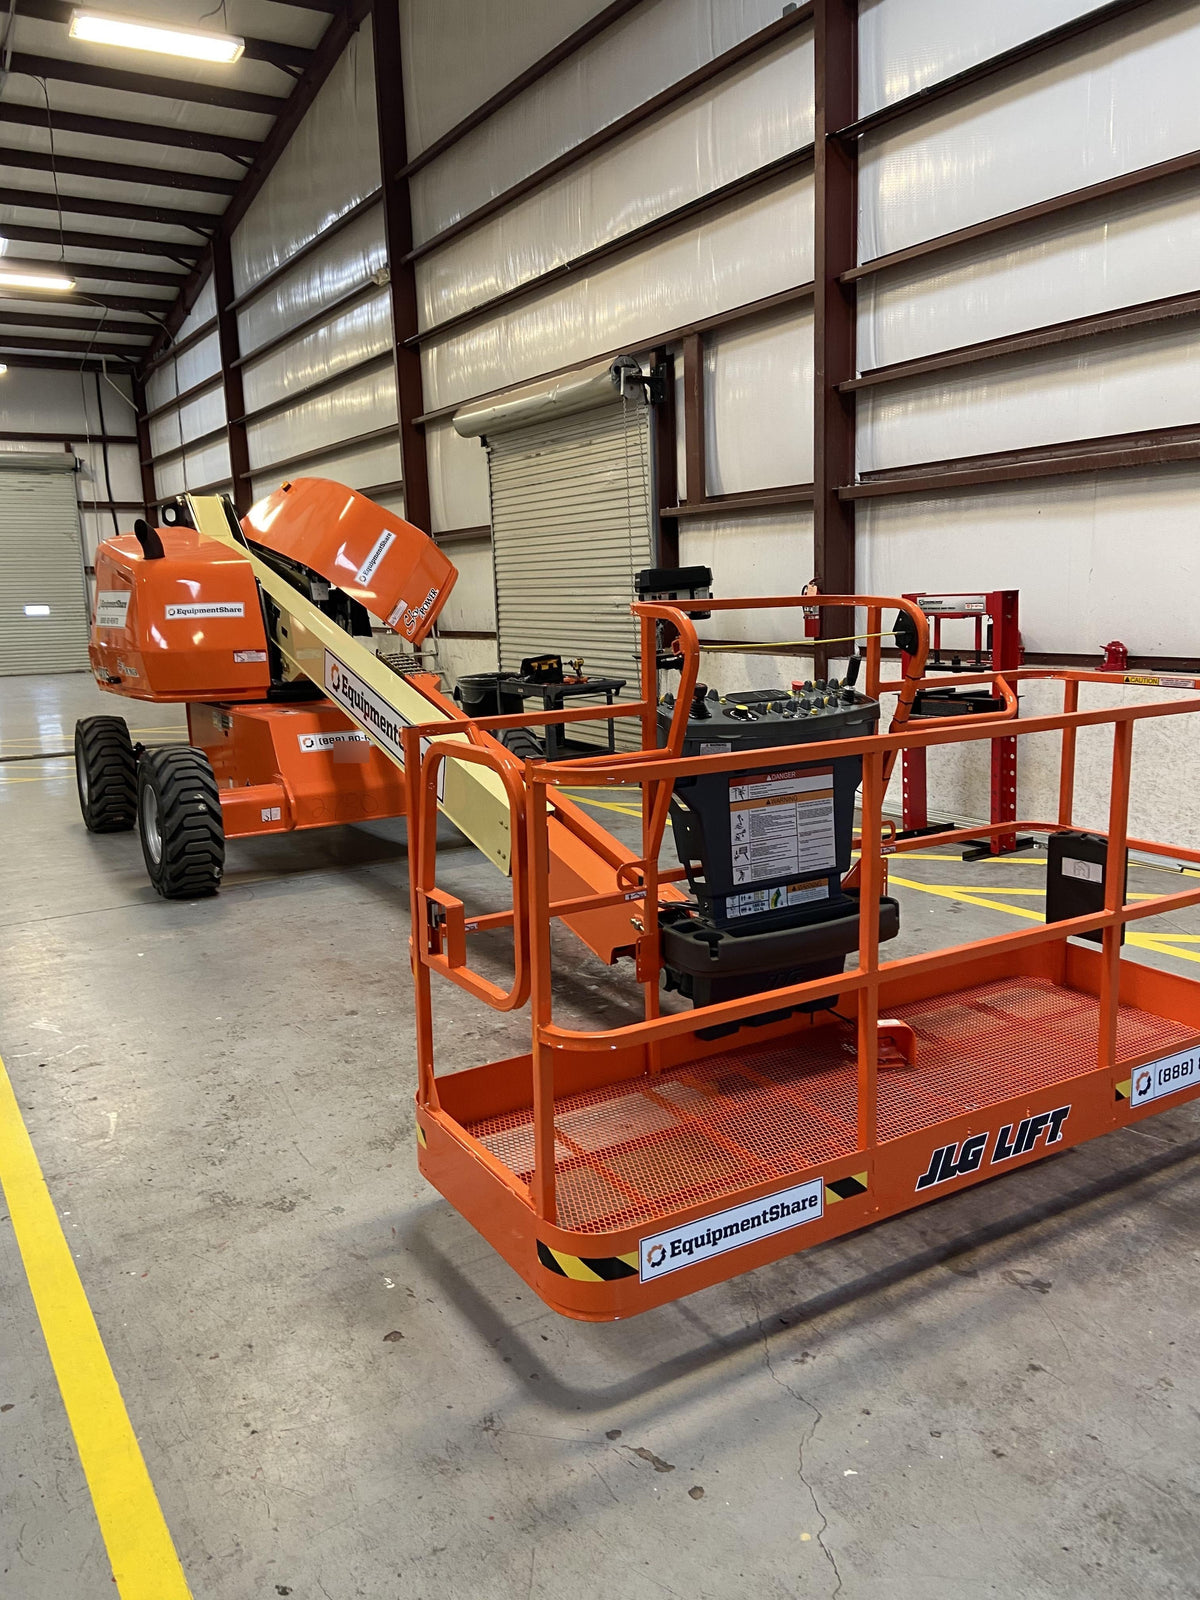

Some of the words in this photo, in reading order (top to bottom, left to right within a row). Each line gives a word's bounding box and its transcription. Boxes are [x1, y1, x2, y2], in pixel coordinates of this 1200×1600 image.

[362, 532, 393, 576] EquipmentShare
[176, 606, 242, 616] EquipmentShare
[419, 588, 439, 618] POWER
[771, 771, 796, 781] DANGER
[771, 795, 798, 805] WARNING
[1158, 1058, 1194, 1086] (888)
[915, 1131, 990, 1192] JLG
[990, 1104, 1072, 1165] LIFT
[669, 1194, 818, 1258] EquipmentShare
